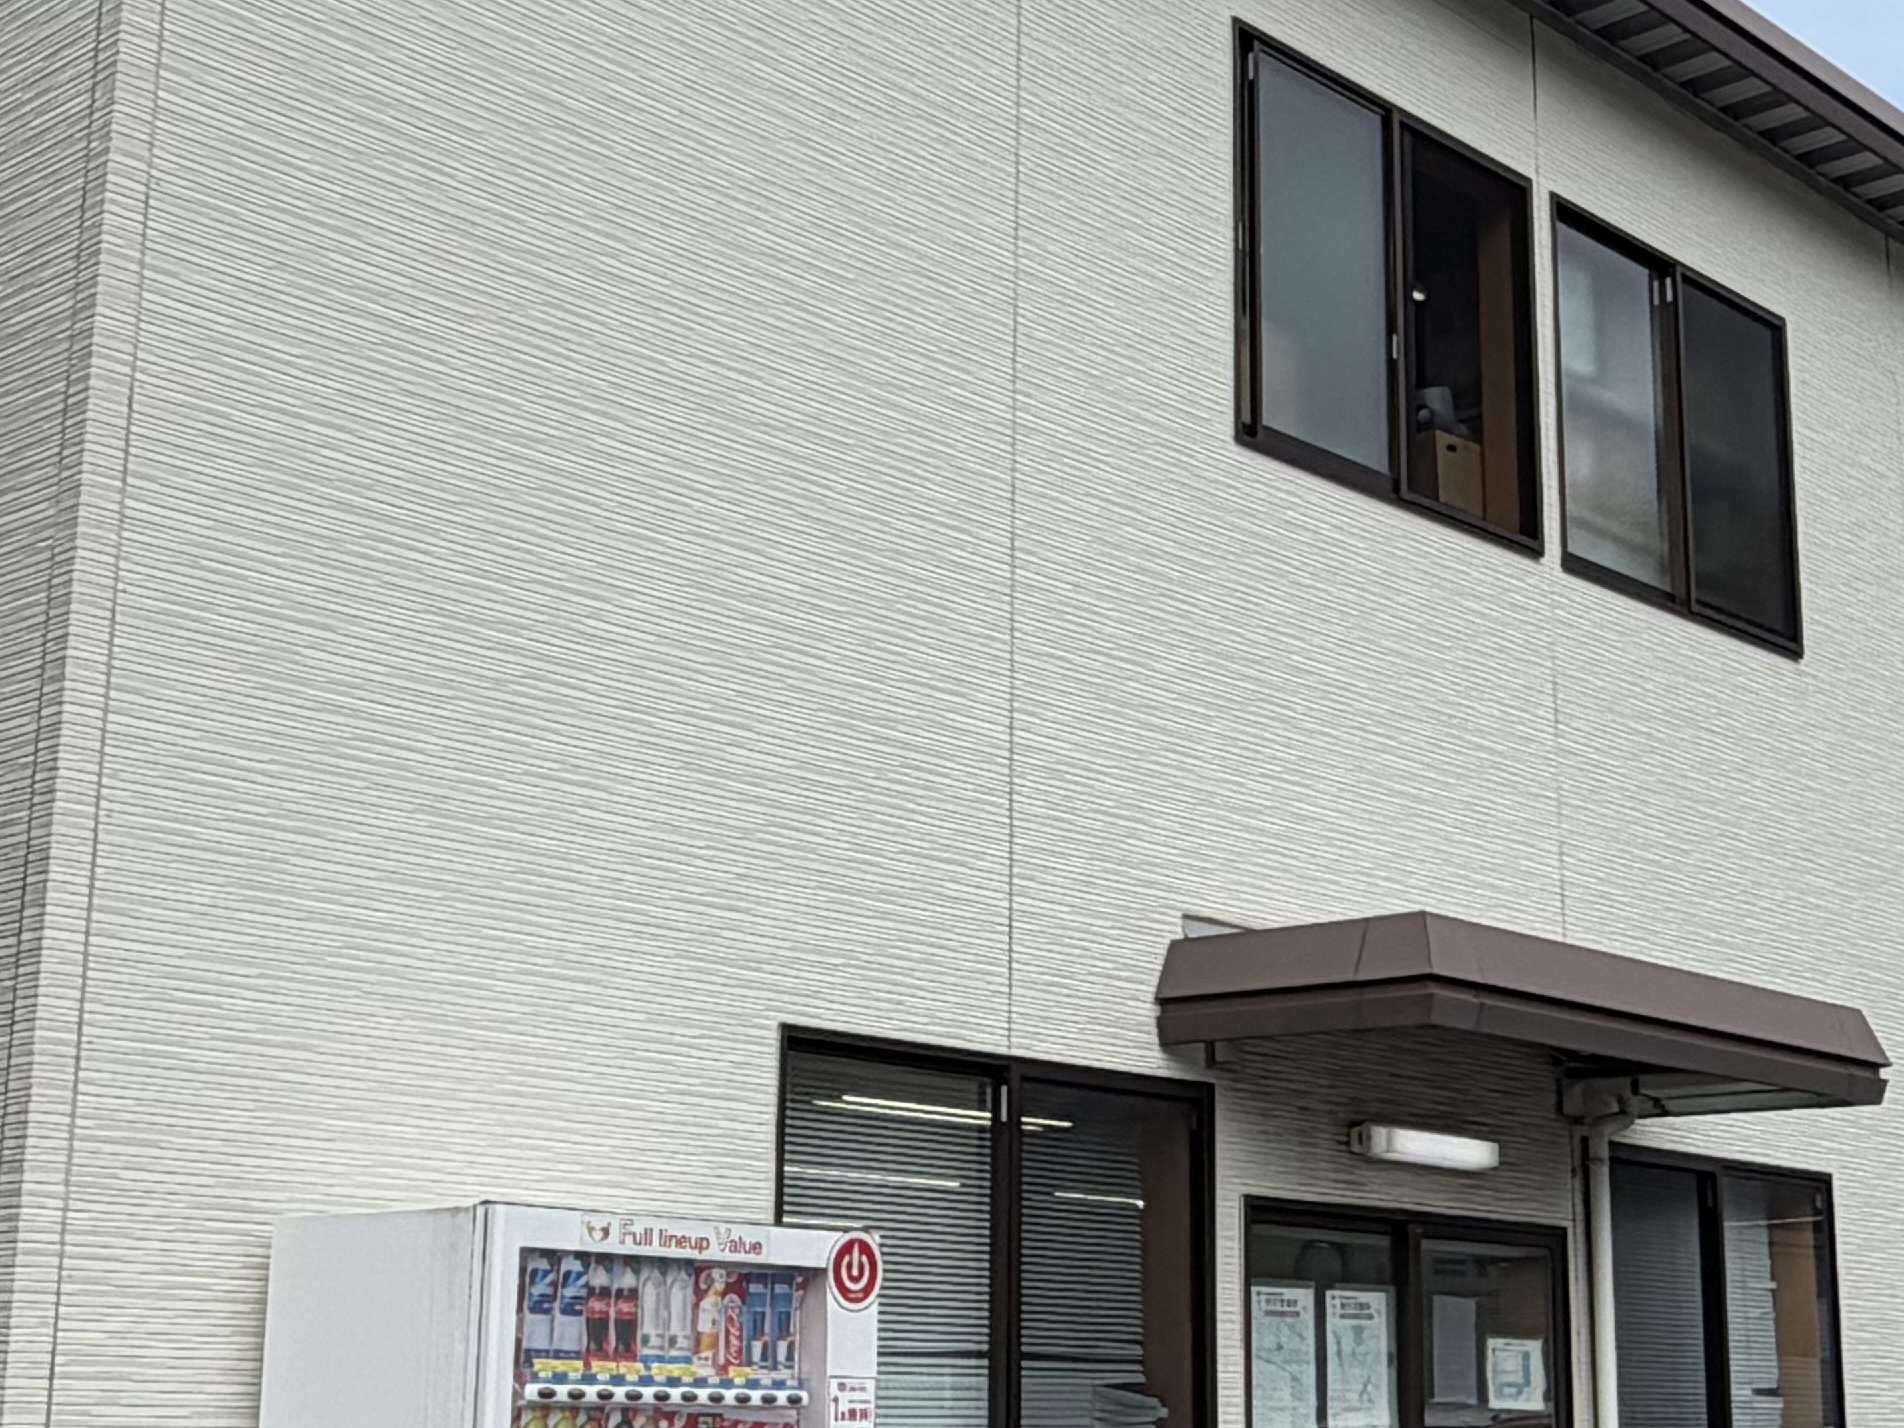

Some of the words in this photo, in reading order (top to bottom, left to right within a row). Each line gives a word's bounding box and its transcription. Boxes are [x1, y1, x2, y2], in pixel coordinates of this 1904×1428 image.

[619, 1218, 653, 1246] Full
[659, 1228, 710, 1254] lineup
[714, 1225, 763, 1255] Value
